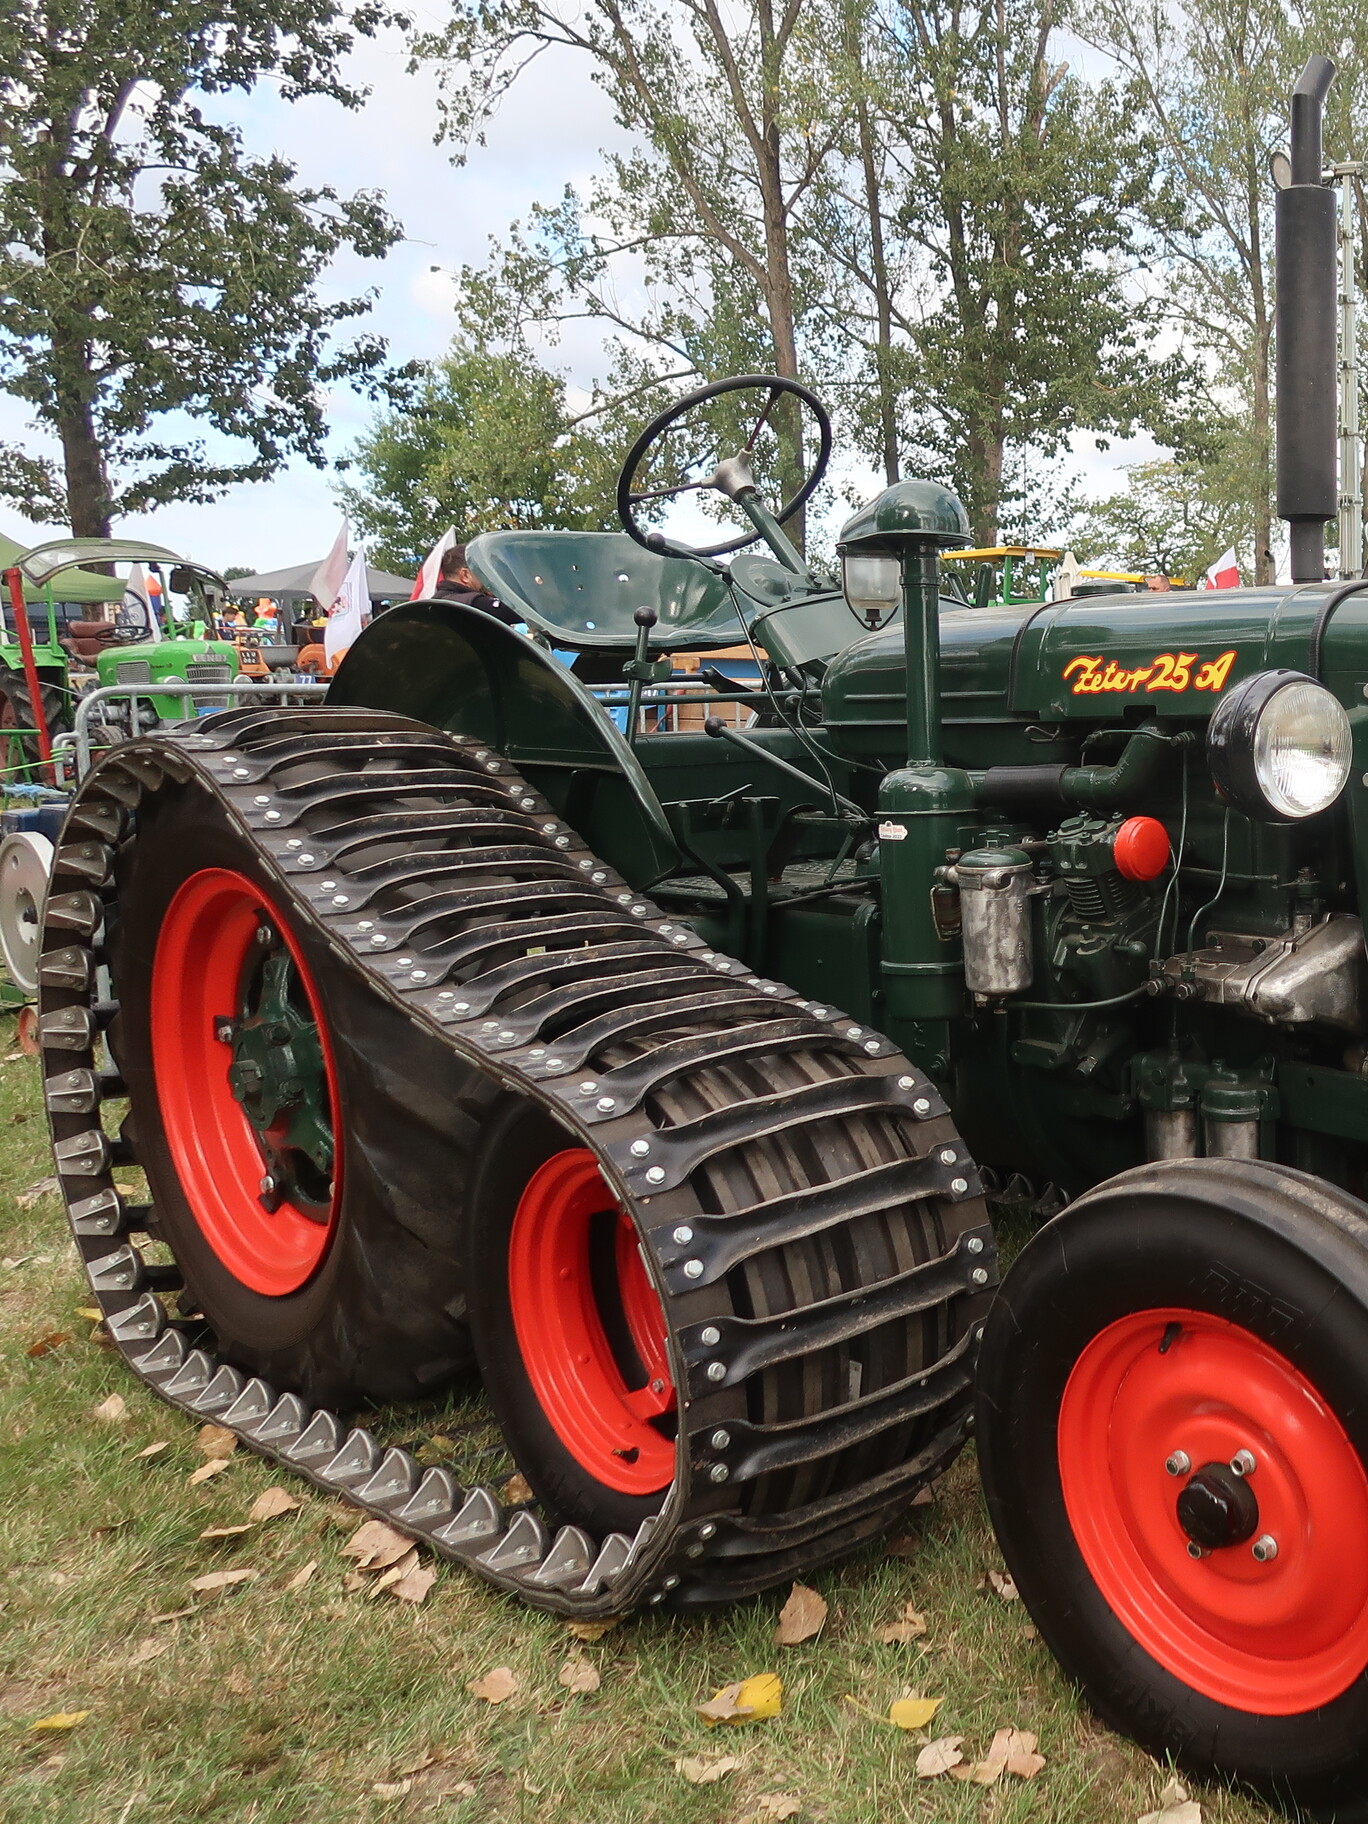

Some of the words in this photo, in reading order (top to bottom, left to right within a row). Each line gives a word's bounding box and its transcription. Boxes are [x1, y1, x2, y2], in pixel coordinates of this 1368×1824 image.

[1062, 655, 1152, 694] Zetor
[1147, 652, 1198, 693] 25
[1194, 650, 1238, 692] A
